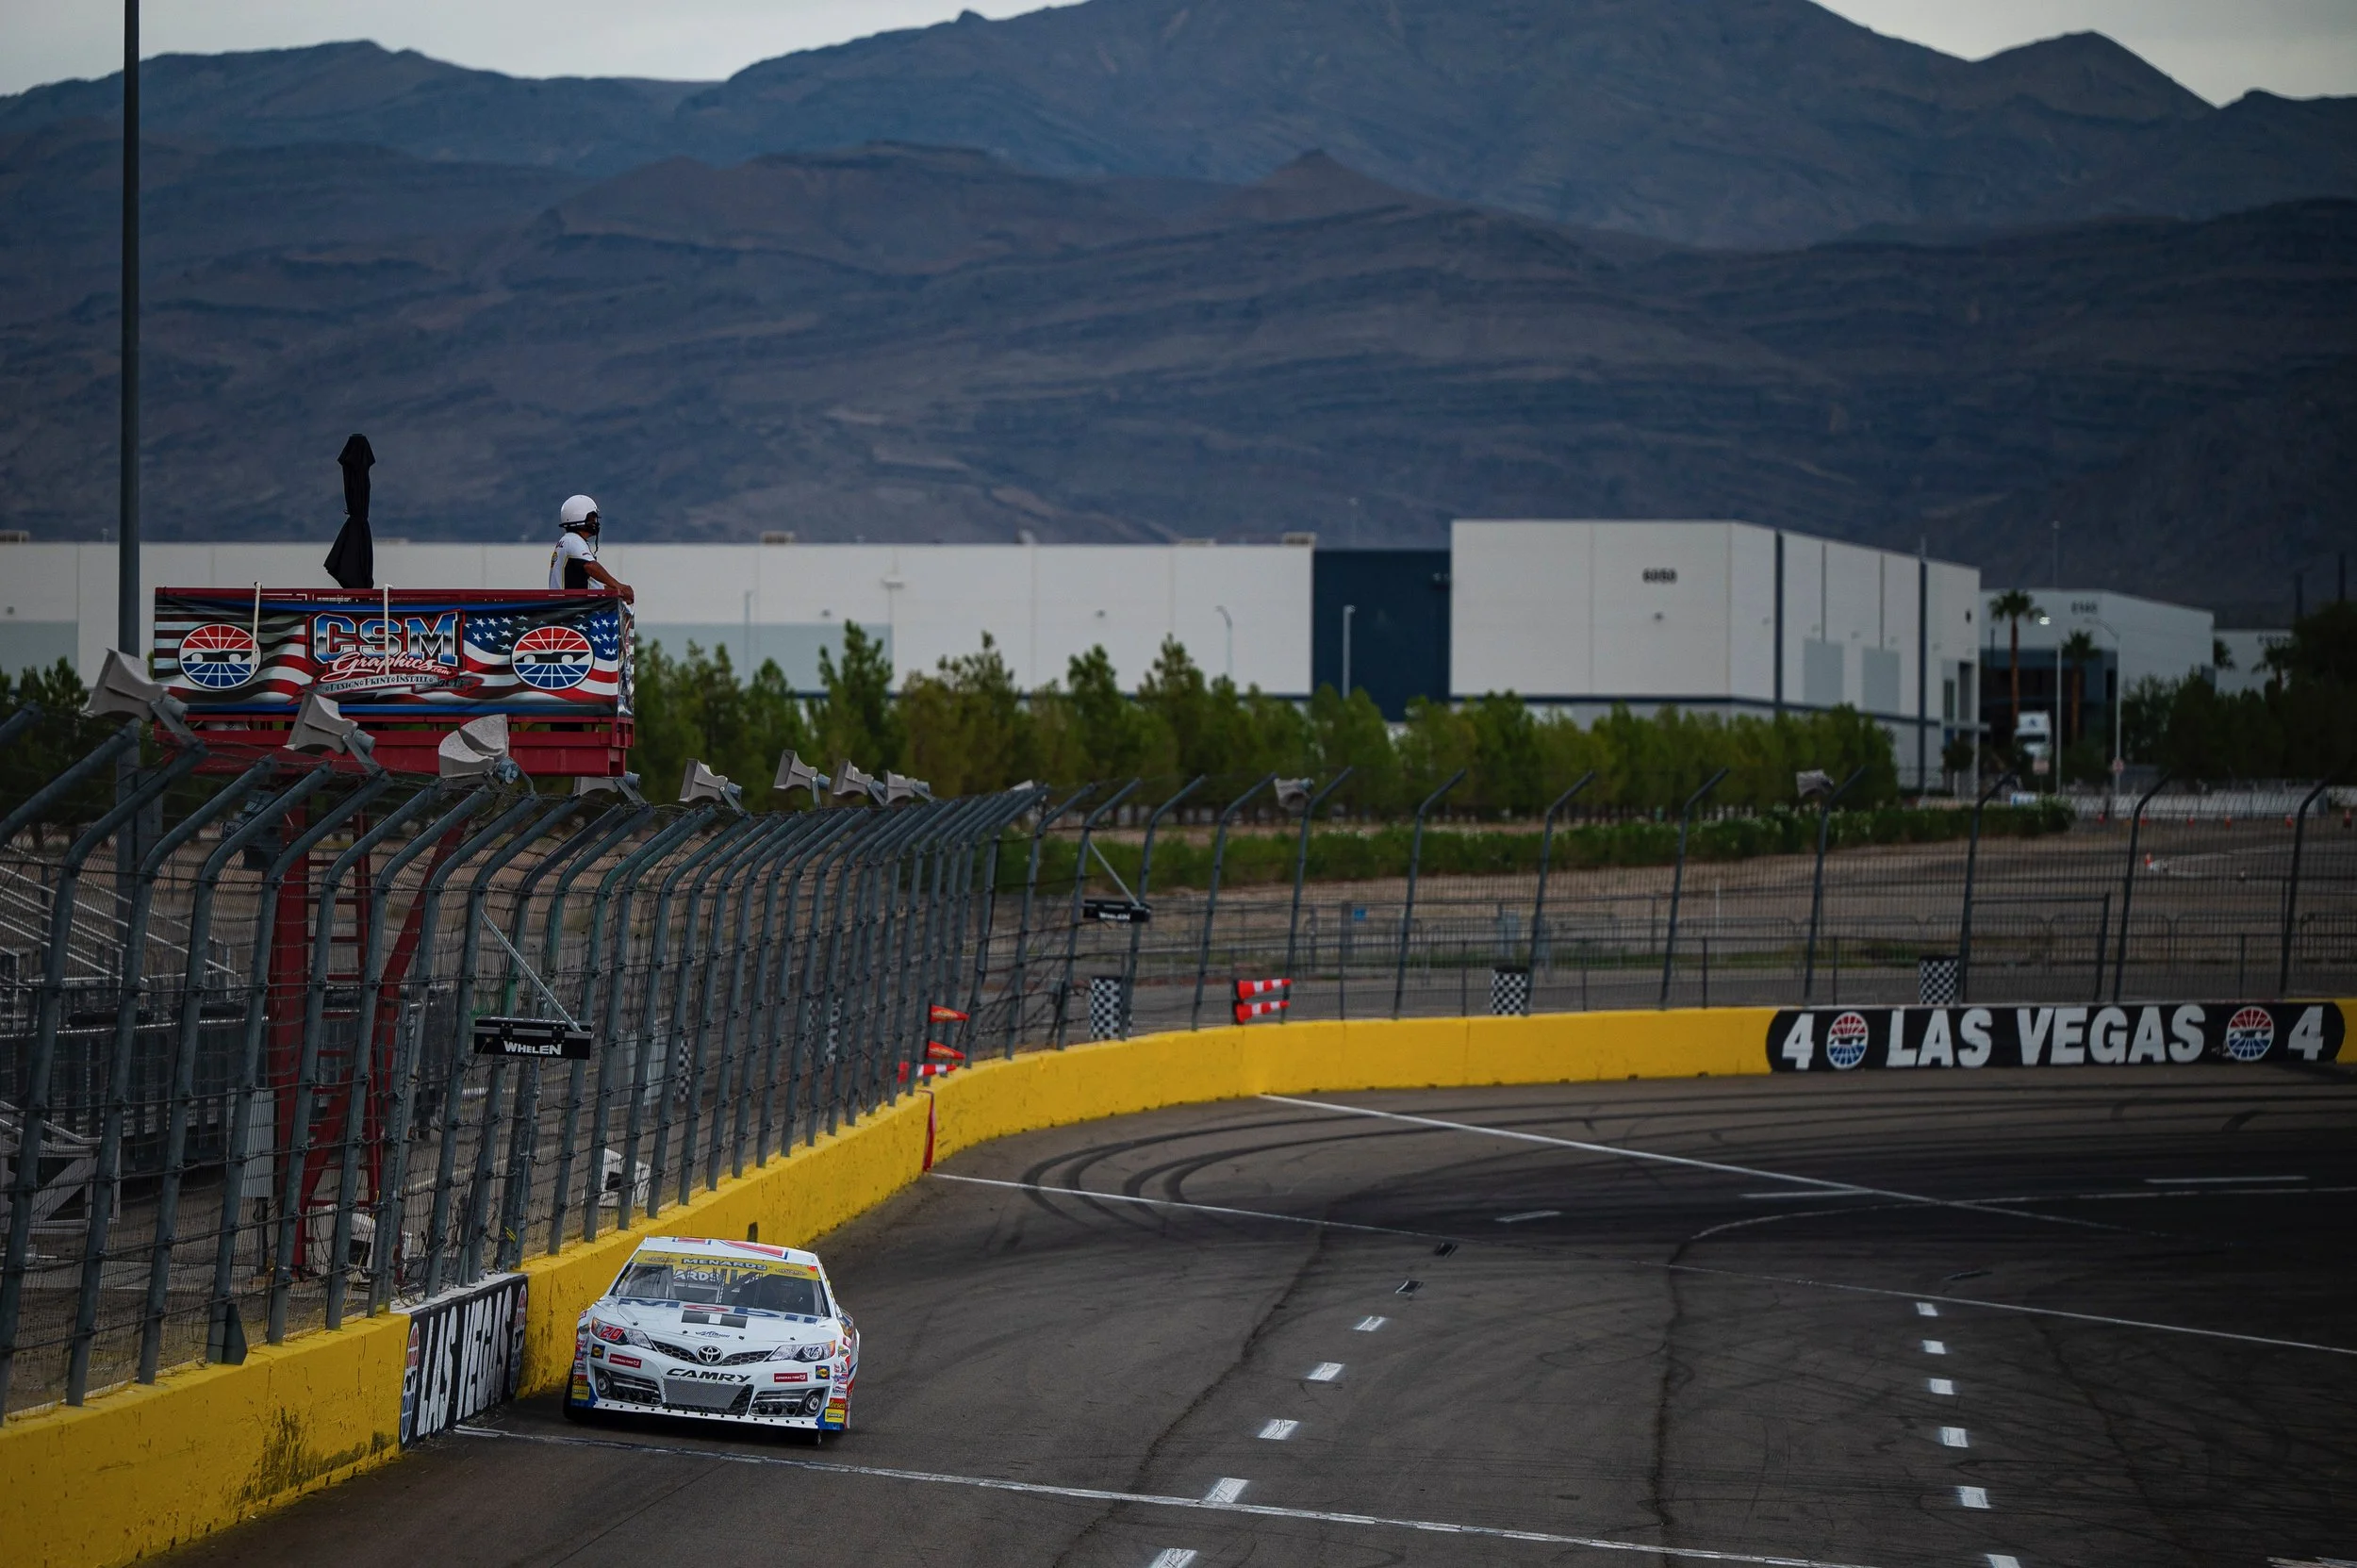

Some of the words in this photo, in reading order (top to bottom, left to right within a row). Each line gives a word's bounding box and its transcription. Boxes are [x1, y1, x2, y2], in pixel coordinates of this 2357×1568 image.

[313, 612, 459, 668] CSM
[365, 677, 391, 685] PRINT
[1781, 1012, 1815, 1070] 4
[1886, 1006, 1994, 1068] LAS
[2016, 1003, 2206, 1066] VEGAS
[2287, 1004, 2325, 1062] 4
[503, 1040, 562, 1056] WHELEN
[681, 1257, 768, 1272] MENARDS
[600, 1326, 624, 1341] 20
[417, 1305, 457, 1437] LAS
[455, 1284, 513, 1421] VEGAS
[666, 1368, 752, 1383] CAMRY
